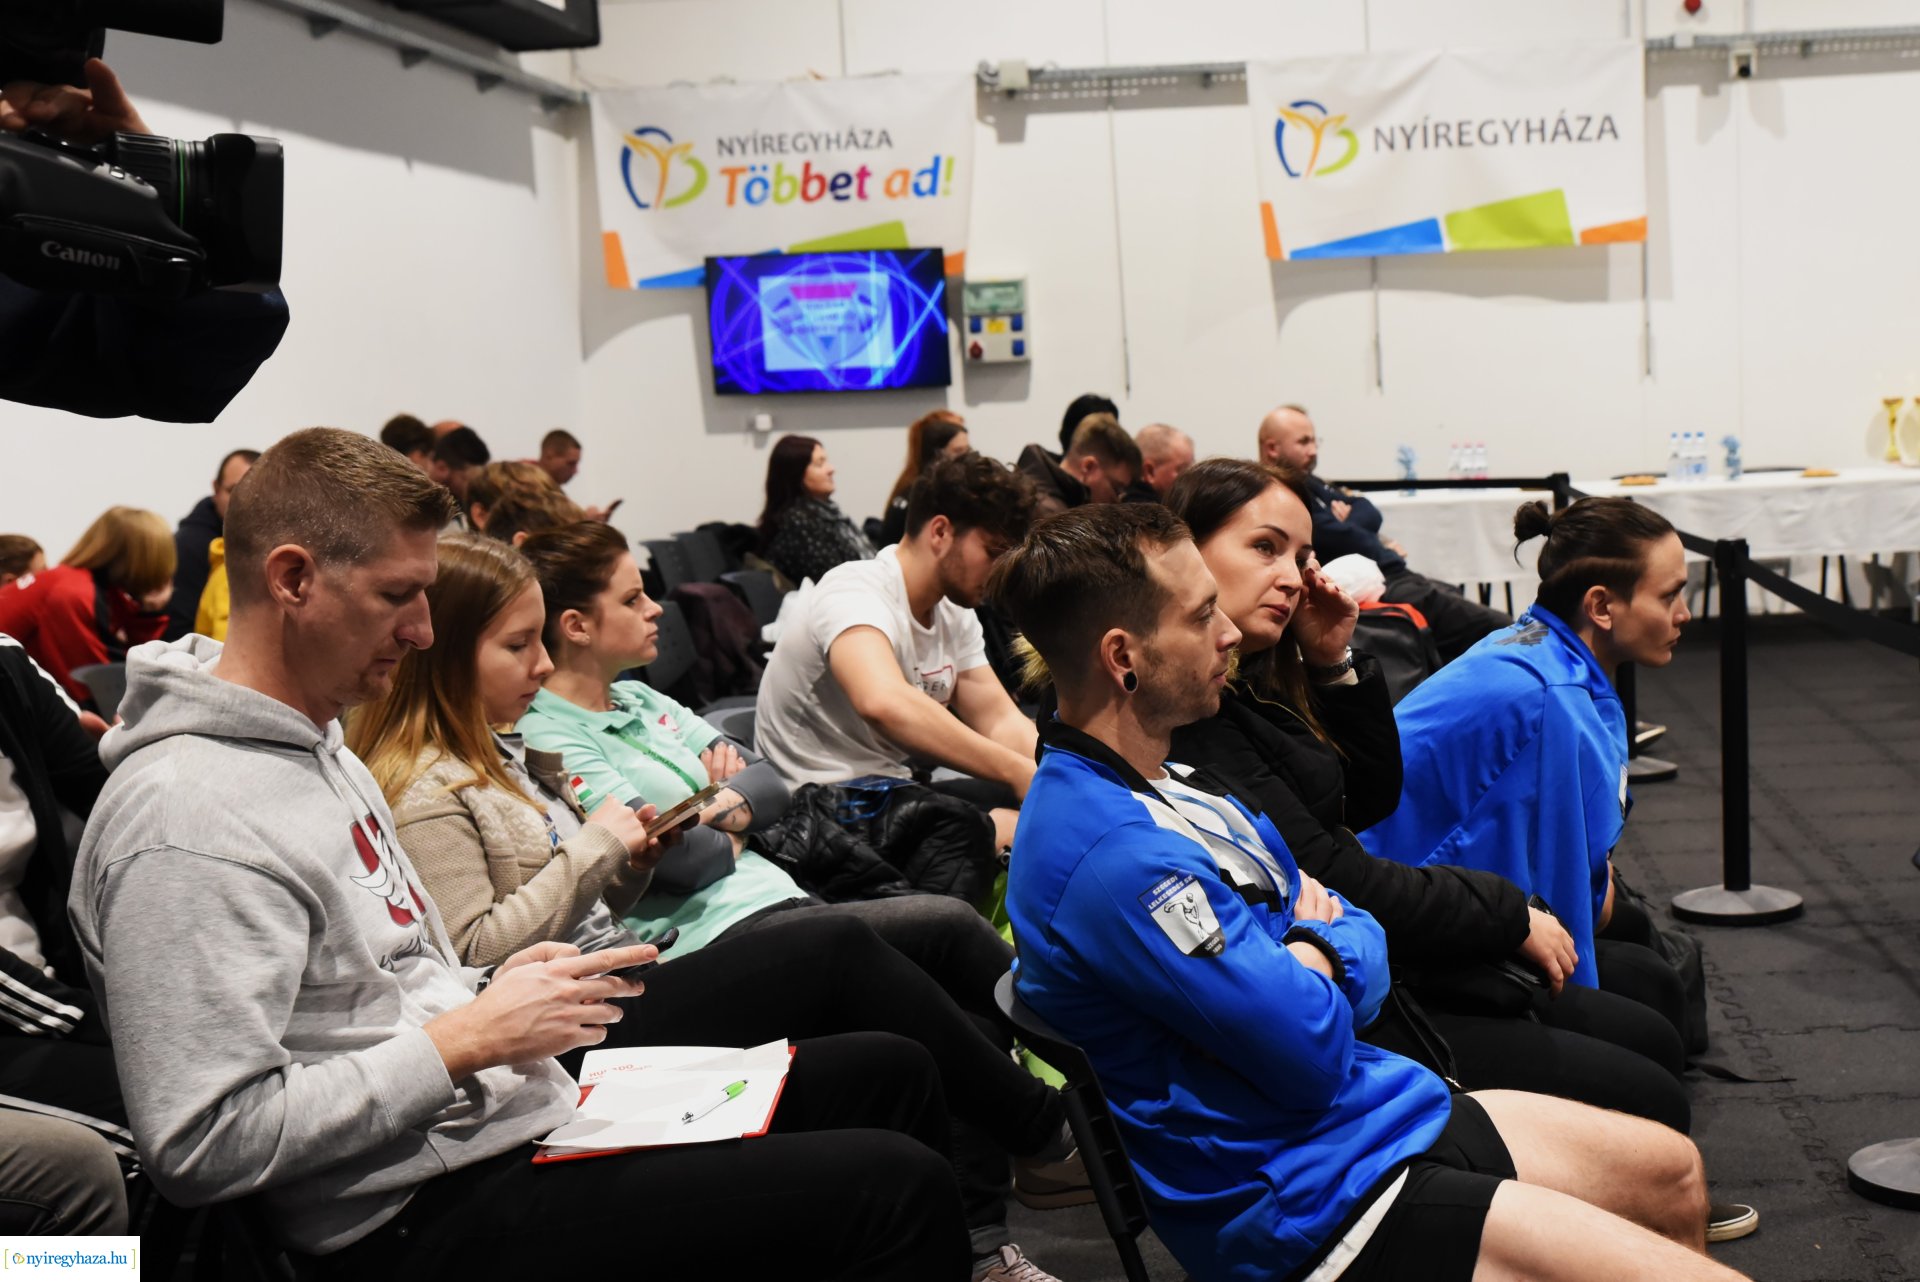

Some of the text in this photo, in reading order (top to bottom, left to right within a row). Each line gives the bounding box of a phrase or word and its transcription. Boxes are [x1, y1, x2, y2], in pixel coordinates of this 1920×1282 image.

[716, 128, 893, 157] NYÍREGYHÁZA
[1373, 109, 1620, 152] NYÍREGYHÁZA
[719, 154, 955, 207] Többet ad!
[40, 240, 121, 270] Canon
